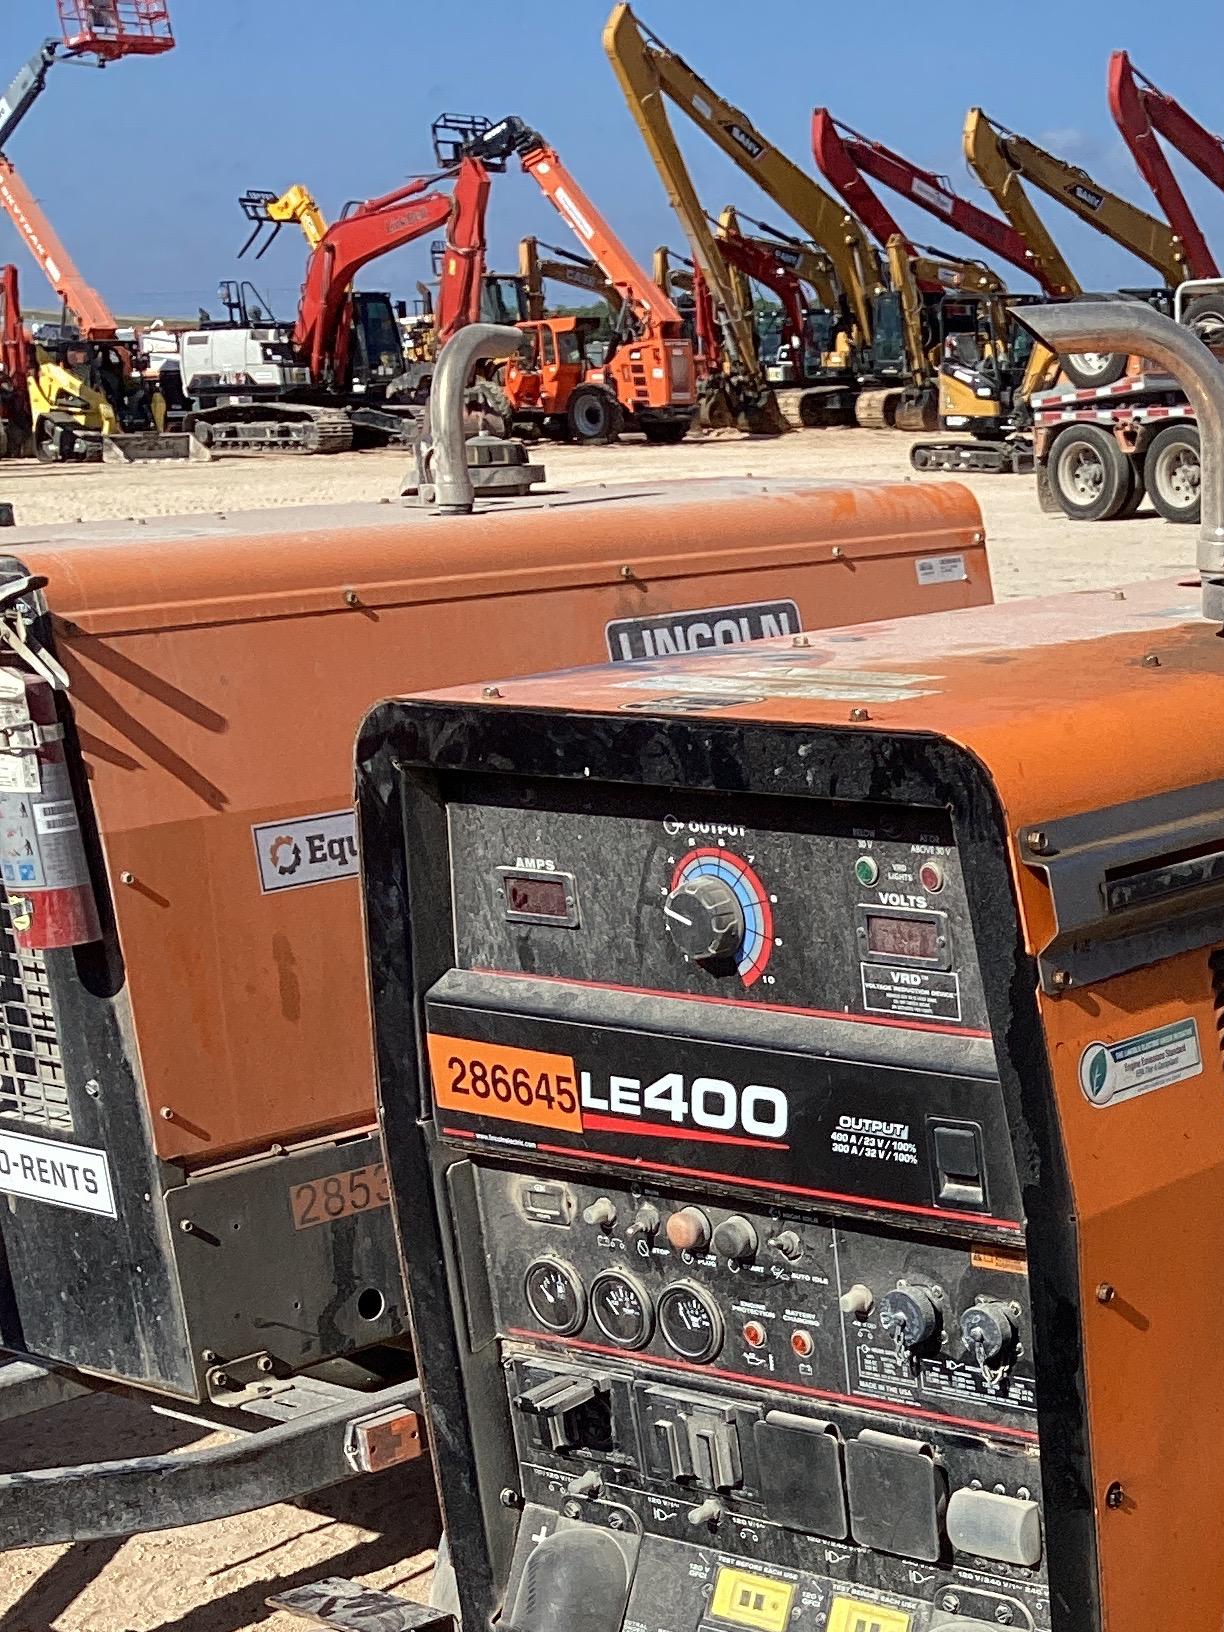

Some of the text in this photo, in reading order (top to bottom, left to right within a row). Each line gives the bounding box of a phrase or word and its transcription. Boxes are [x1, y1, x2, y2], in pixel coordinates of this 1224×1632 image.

[688, 821, 746, 837] OUTPUT
[516, 857, 556, 871] AMPS
[879, 891, 928, 909] VOLTS
[763, 975, 775, 984] 10
[447, 1055, 577, 1114] 286645
[580, 1071, 789, 1138] LE400
[838, 1115, 906, 1136] OUTPUT
[830, 1132, 848, 1142] 400
[864, 1136, 876, 1147] 23
[892, 1140, 917, 1154] 100%
[832, 1142, 850, 1154] 300
[864, 1148, 877, 1158] 32
[893, 1152, 918, 1164] 100%
[791, 1272, 829, 1285] AUTO IDLE
[732, 1304, 776, 1319] PROTECTION
[785, 1308, 816, 1320] BATTERY
[898, 1387, 912, 1396] USA
[689, 1562, 704, 1571] 120
[718, 1556, 799, 1580] TEST BEFORE EACH USE
[802, 1591, 817, 1600] 120
[832, 1583, 918, 1610] TEST BEFORE EACH USE
